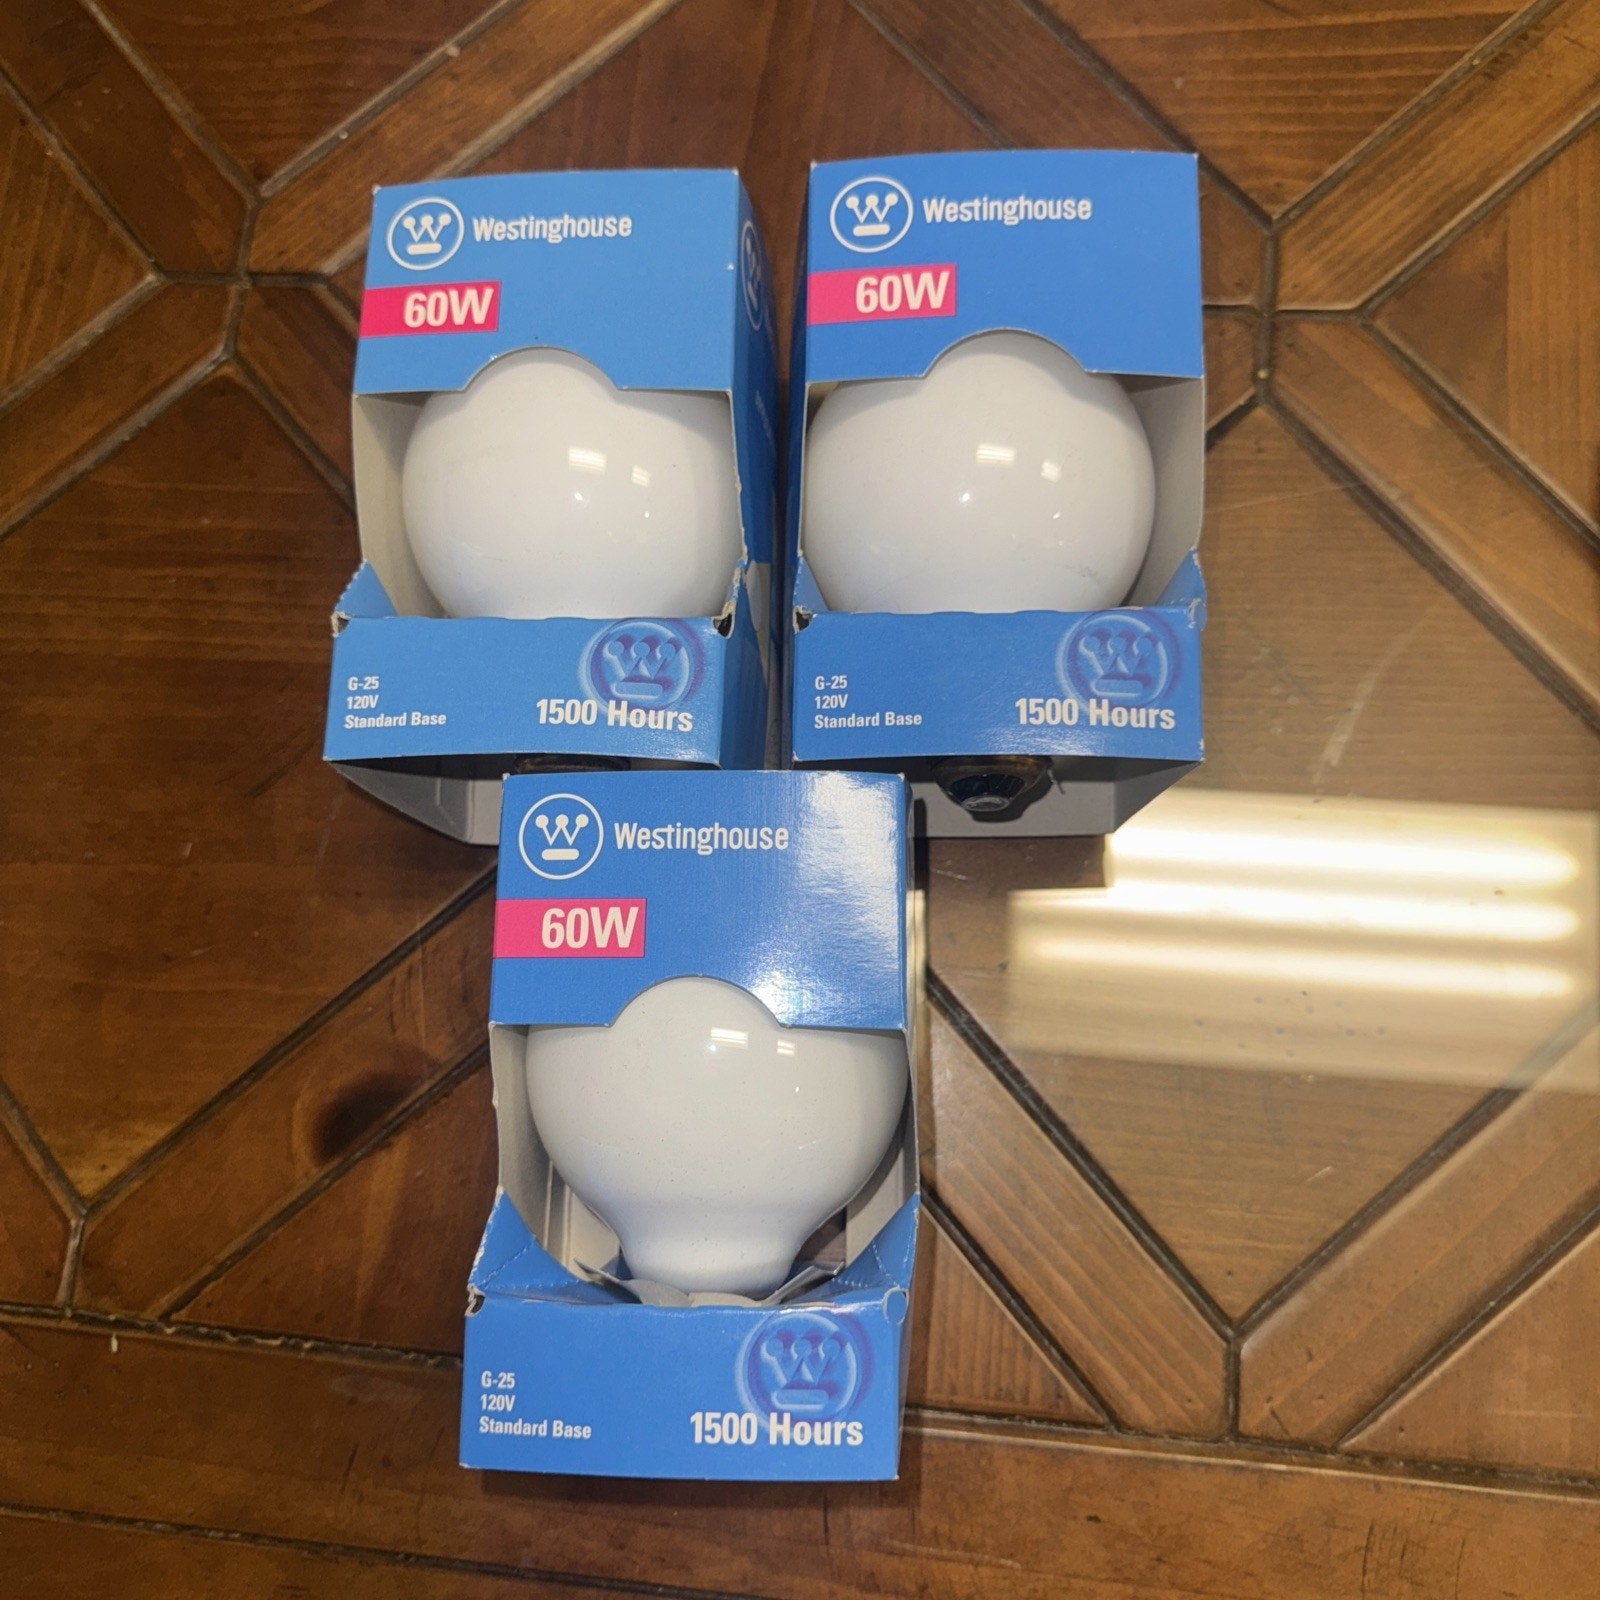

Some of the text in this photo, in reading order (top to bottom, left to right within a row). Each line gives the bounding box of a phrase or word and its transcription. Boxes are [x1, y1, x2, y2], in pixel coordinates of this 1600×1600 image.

[922, 195, 1093, 226] Westinghouse
[473, 213, 633, 243] Westinghouse
[855, 270, 950, 314] 60W
[403, 285, 495, 328] 60W
[347, 676, 380, 691] G-25
[814, 675, 848, 690] G-25
[346, 694, 379, 710] 120V
[814, 694, 848, 709] 120V
[1014, 698, 1176, 730] 1500 Hours
[344, 711, 447, 730] Standard Base
[536, 698, 694, 732] 1500 Hours
[813, 711, 923, 729] Standard Base
[614, 821, 789, 856] Westinghouse
[541, 906, 640, 949] 60W
[481, 1371, 516, 1389] G-25
[479, 1394, 516, 1412] 120V
[478, 1416, 592, 1439] Standard Base
[689, 1411, 864, 1446] 1500 Hours
